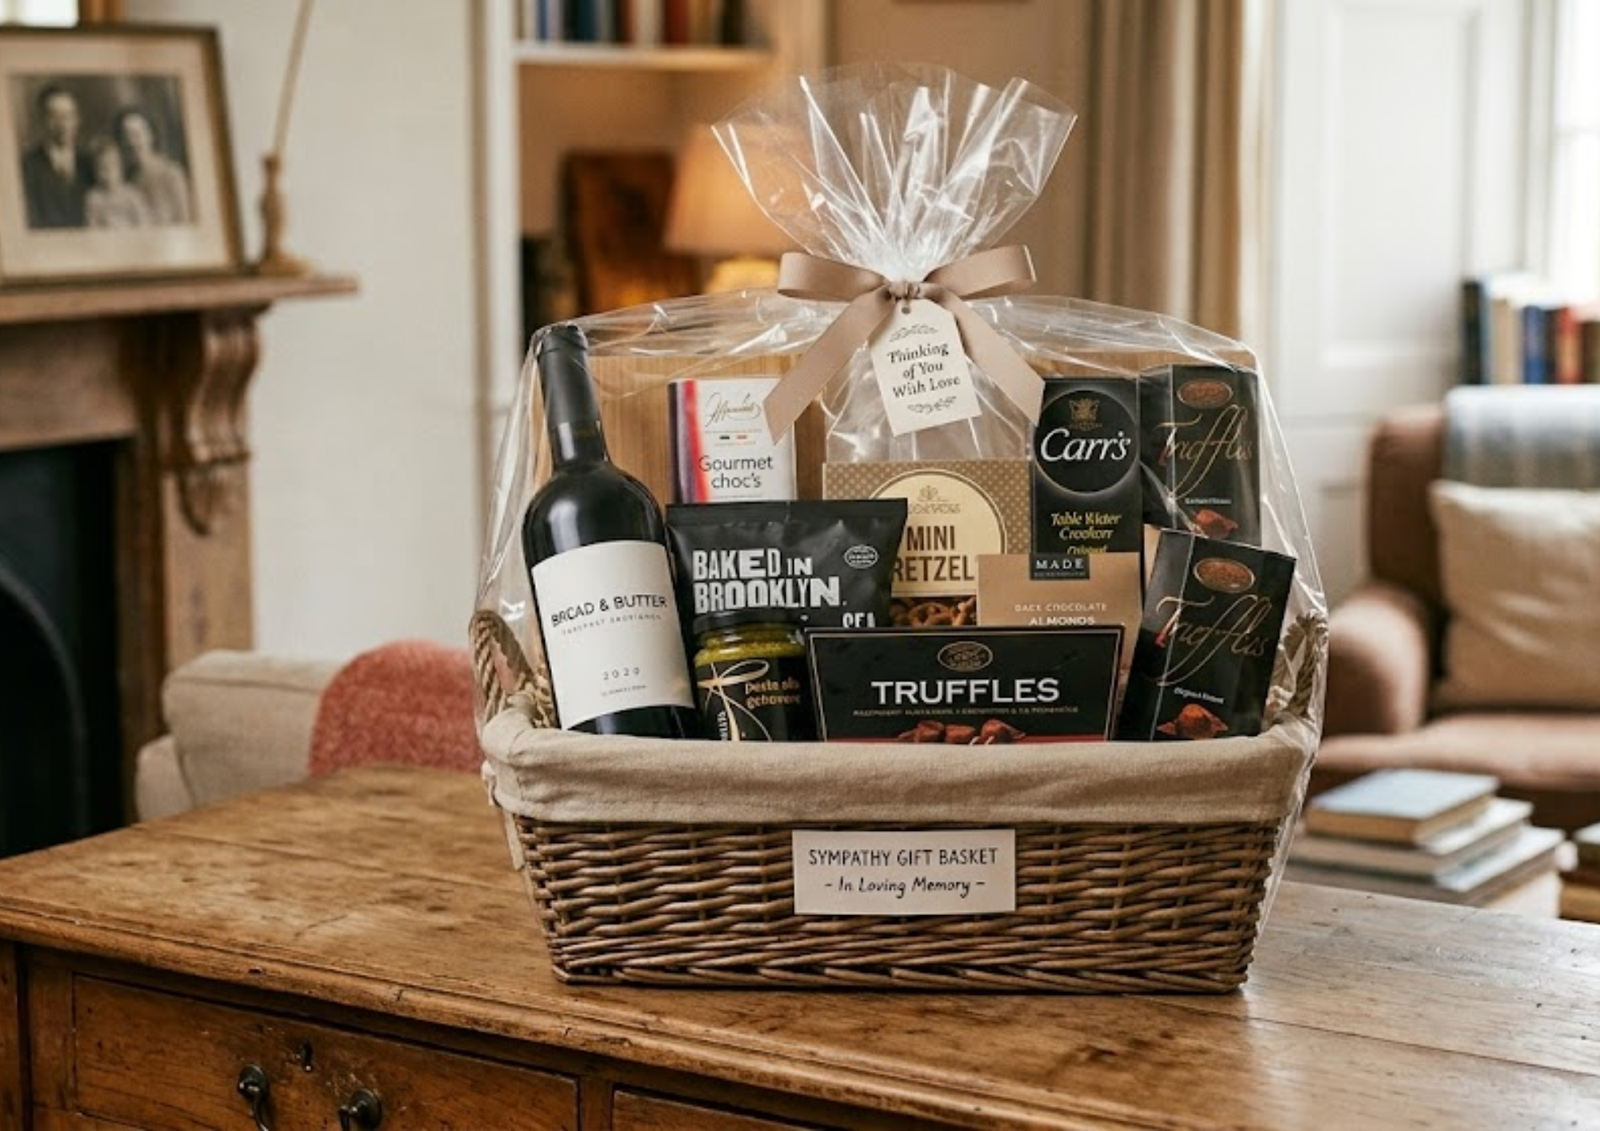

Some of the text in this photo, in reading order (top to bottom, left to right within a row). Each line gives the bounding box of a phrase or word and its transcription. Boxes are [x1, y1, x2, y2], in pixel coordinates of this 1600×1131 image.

[887, 343, 949, 364] Thinking
[902, 362, 943, 380] of You
[1040, 427, 1131, 461] Carr's
[699, 455, 773, 472] Gourmet
[711, 472, 762, 489] choc's
[907, 525, 955, 551] MINI
[693, 548, 813, 579] BAKED IN
[892, 556, 975, 581] RETZEL
[1036, 558, 1084, 570] MADE
[600, 599, 609, 612] &
[613, 594, 667, 609] BUTTER
[871, 678, 1060, 705] TRUFFLES
[809, 848, 999, 866] SYMPATHY GIFT BASKET
[838, 876, 852, 891] In
[858, 877, 906, 899] Loving
[911, 876, 971, 899] Memory
